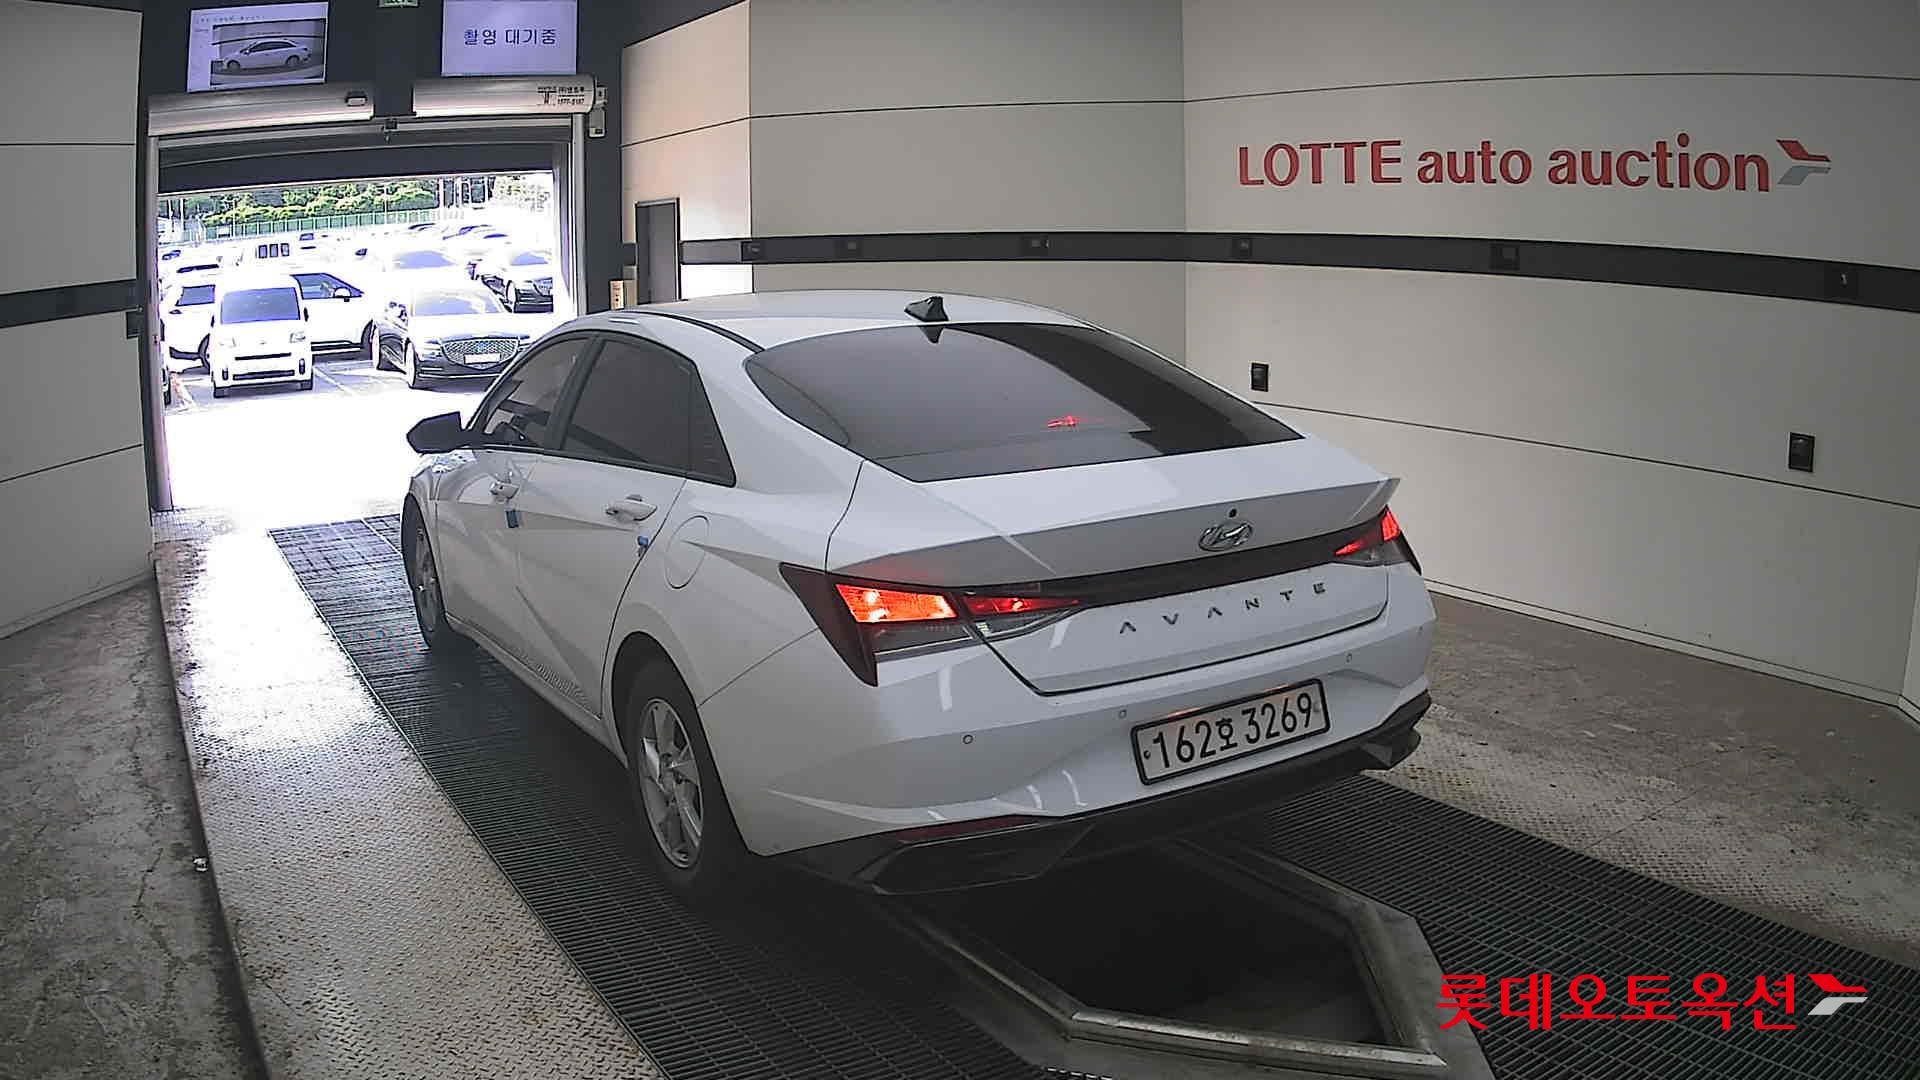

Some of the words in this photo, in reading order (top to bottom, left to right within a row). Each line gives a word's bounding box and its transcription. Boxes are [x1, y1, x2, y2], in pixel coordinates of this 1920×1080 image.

[464, 29, 497, 46] 촬영
[504, 28, 556, 46] 대기중
[1238, 139, 1402, 187] LOTTE
[1416, 140, 1532, 185] auto
[1547, 132, 1770, 193] auction
[1119, 582, 1327, 635] AVANTE
[1152, 717, 1238, 769] 162호
[1241, 692, 1313, 744] 3269
